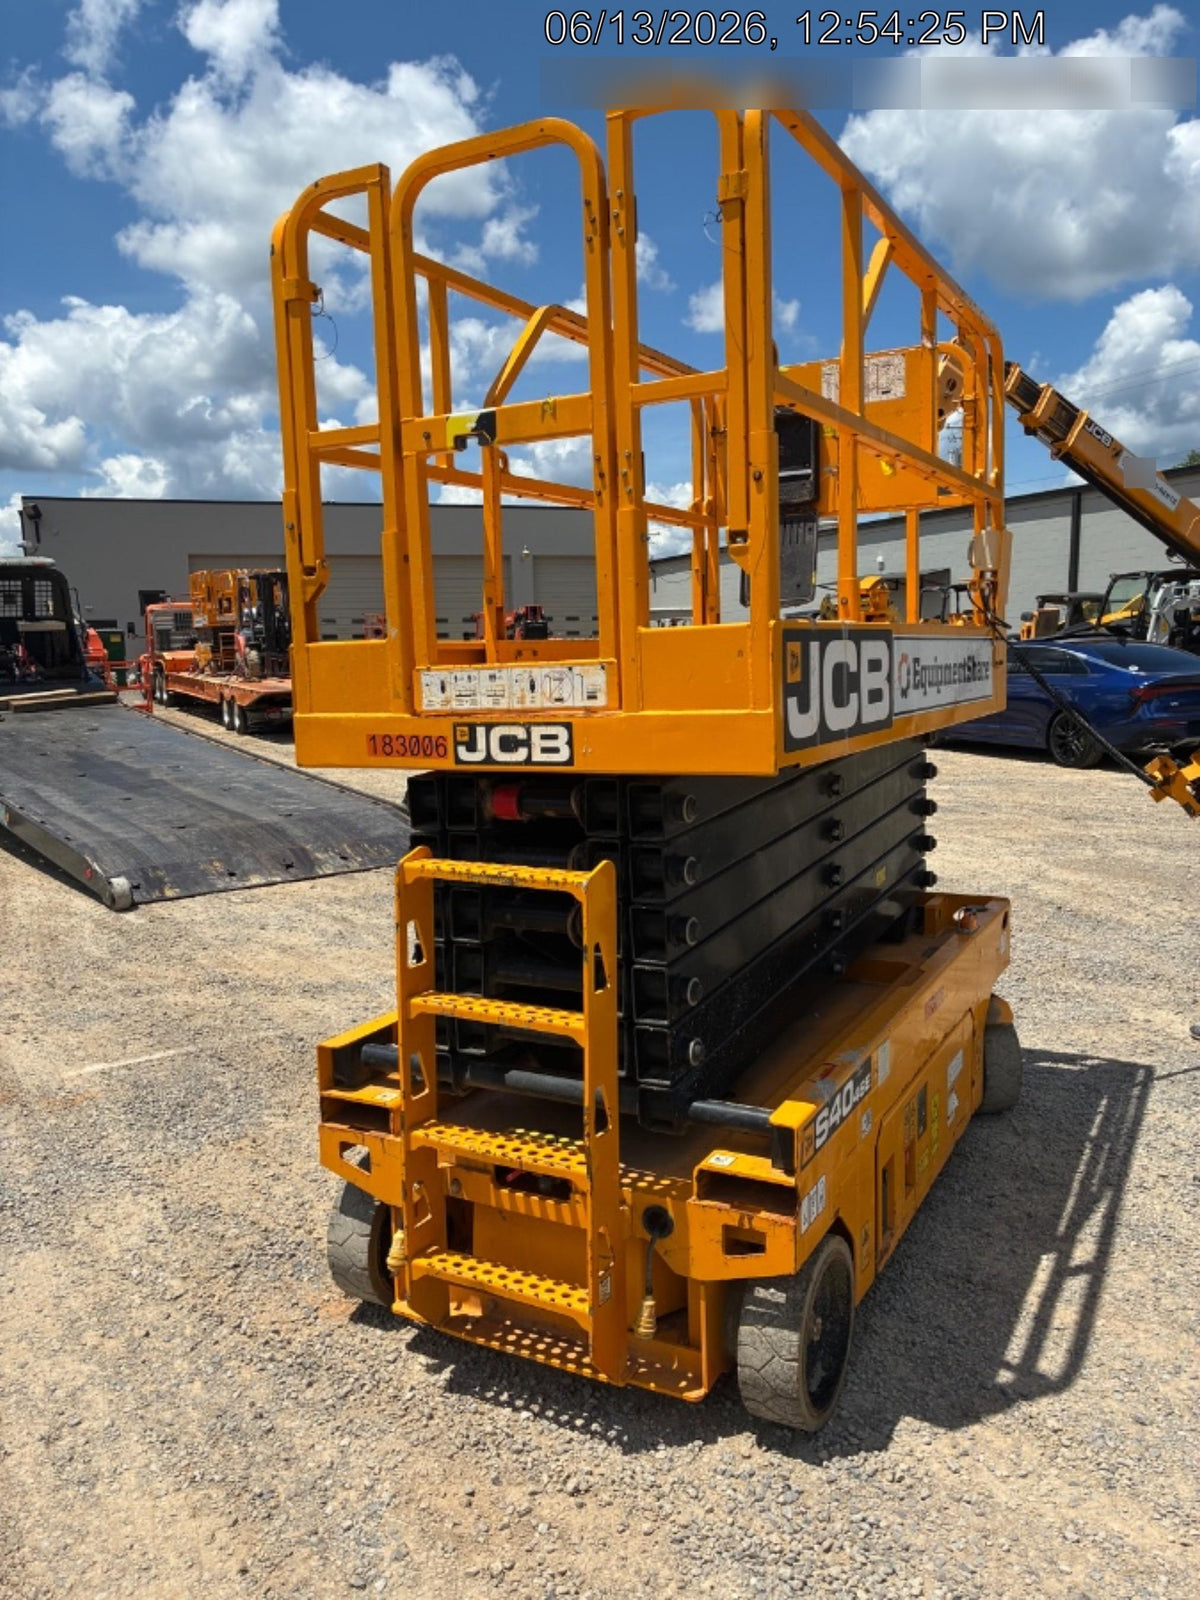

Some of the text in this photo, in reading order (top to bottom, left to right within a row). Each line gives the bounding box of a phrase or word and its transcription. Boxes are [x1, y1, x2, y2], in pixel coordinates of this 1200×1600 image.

[1085, 423, 1112, 447] JCB
[786, 639, 890, 739] JCB
[912, 656, 990, 695] EquipmentShare
[369, 734, 447, 758] 183006
[457, 726, 571, 763] JCB
